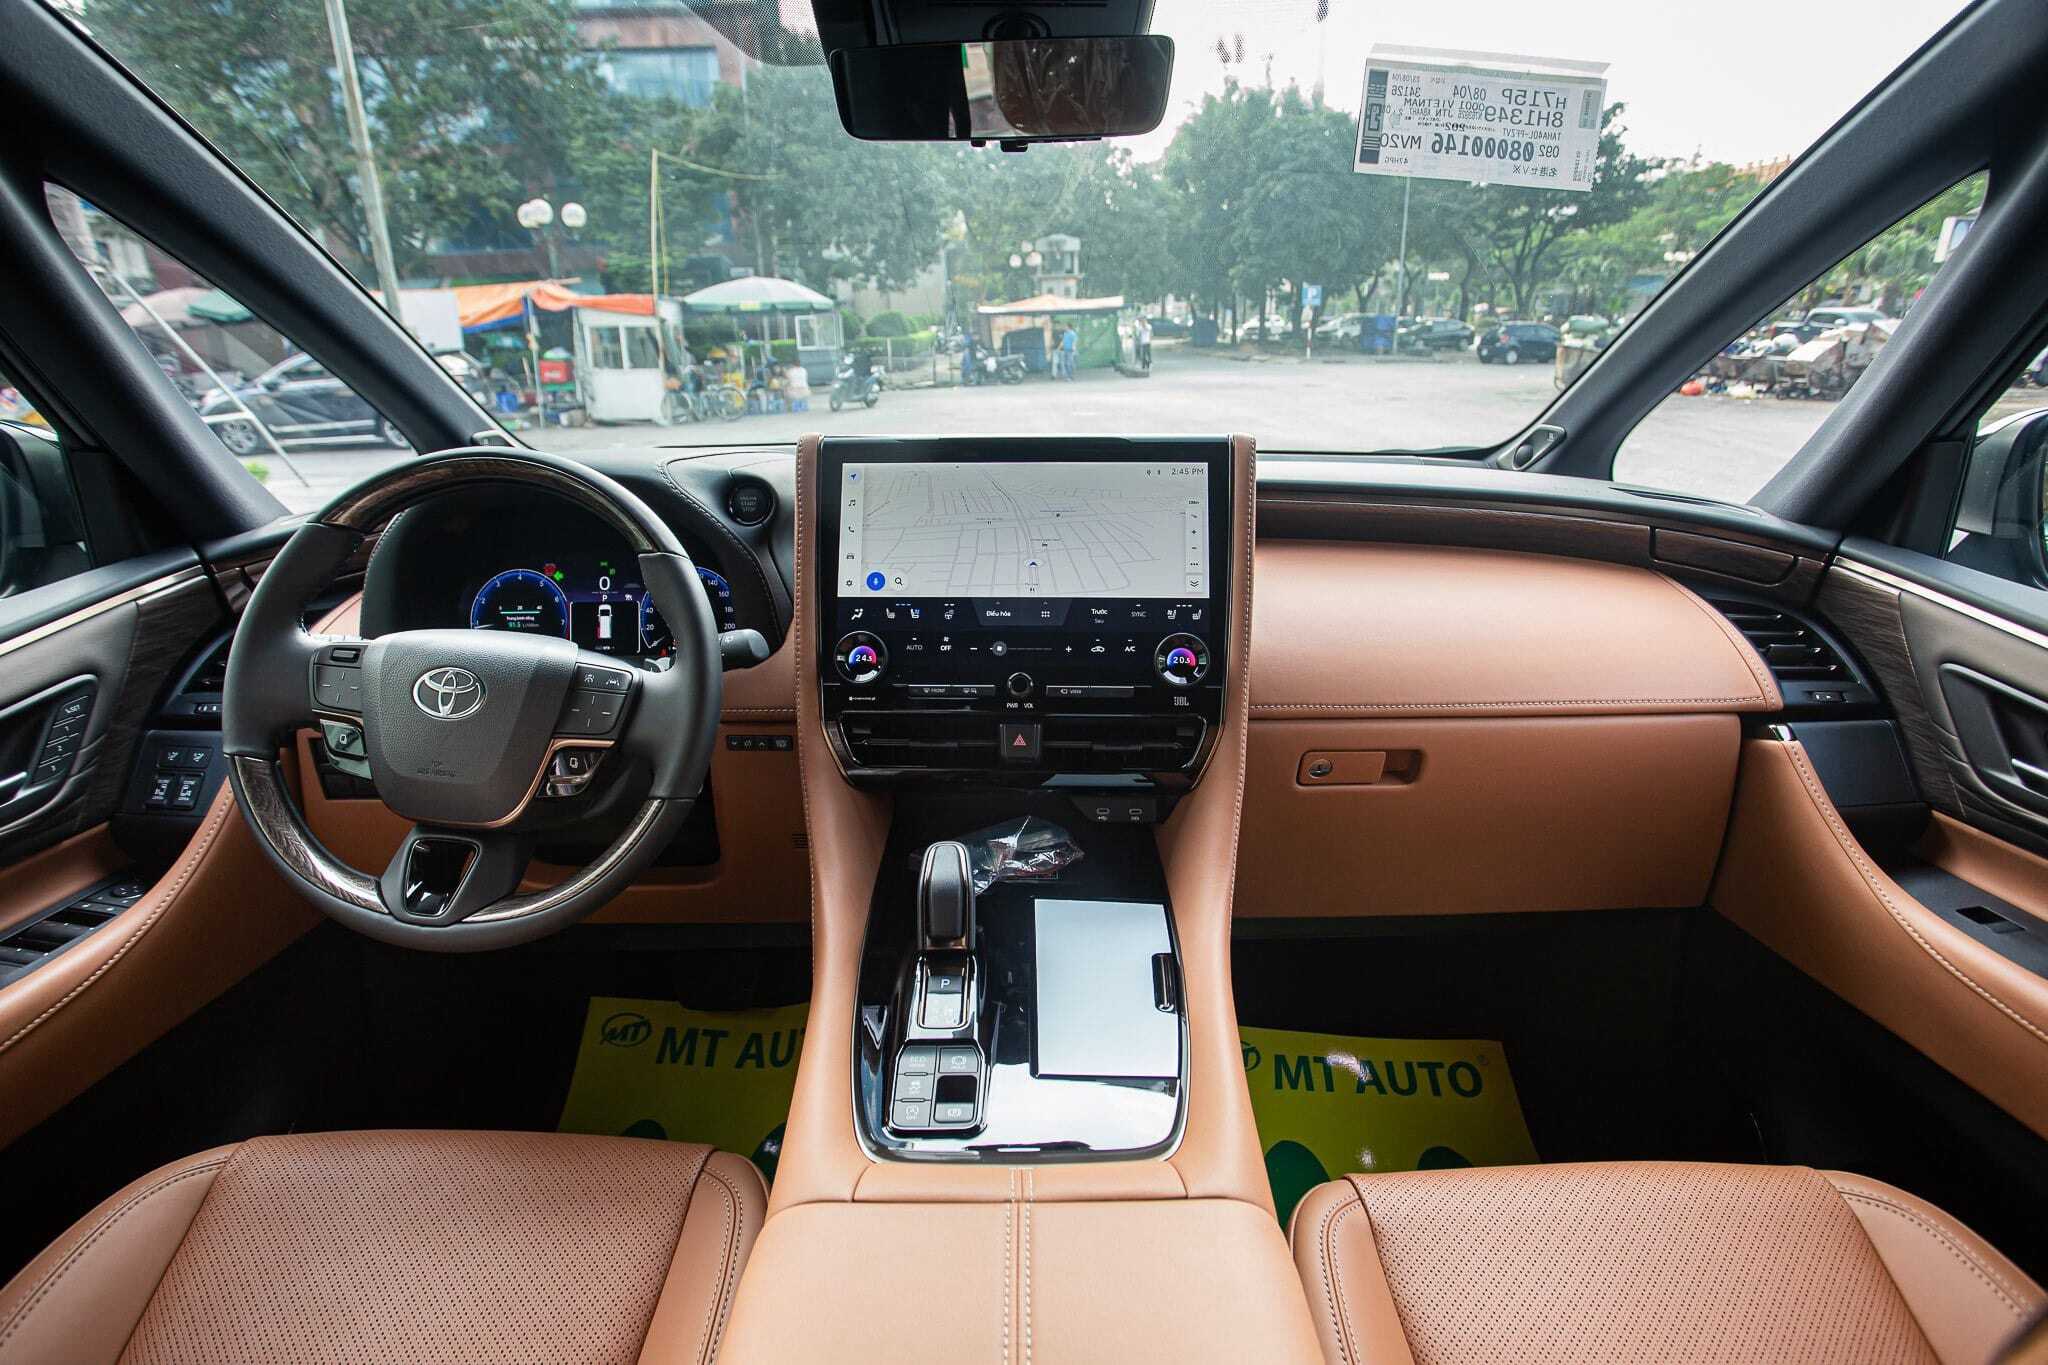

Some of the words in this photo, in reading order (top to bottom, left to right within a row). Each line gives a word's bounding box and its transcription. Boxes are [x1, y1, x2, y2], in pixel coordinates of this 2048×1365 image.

[1307, 287, 1318, 298] P
[599, 576, 611, 592] 0
[602, 594, 608, 602] P
[941, 978, 950, 989] P
[655, 1026, 729, 1068] MT
[735, 1028, 806, 1069] AU
[1274, 1054, 1338, 1093] MT
[1356, 1059, 1483, 1098] AUTO
